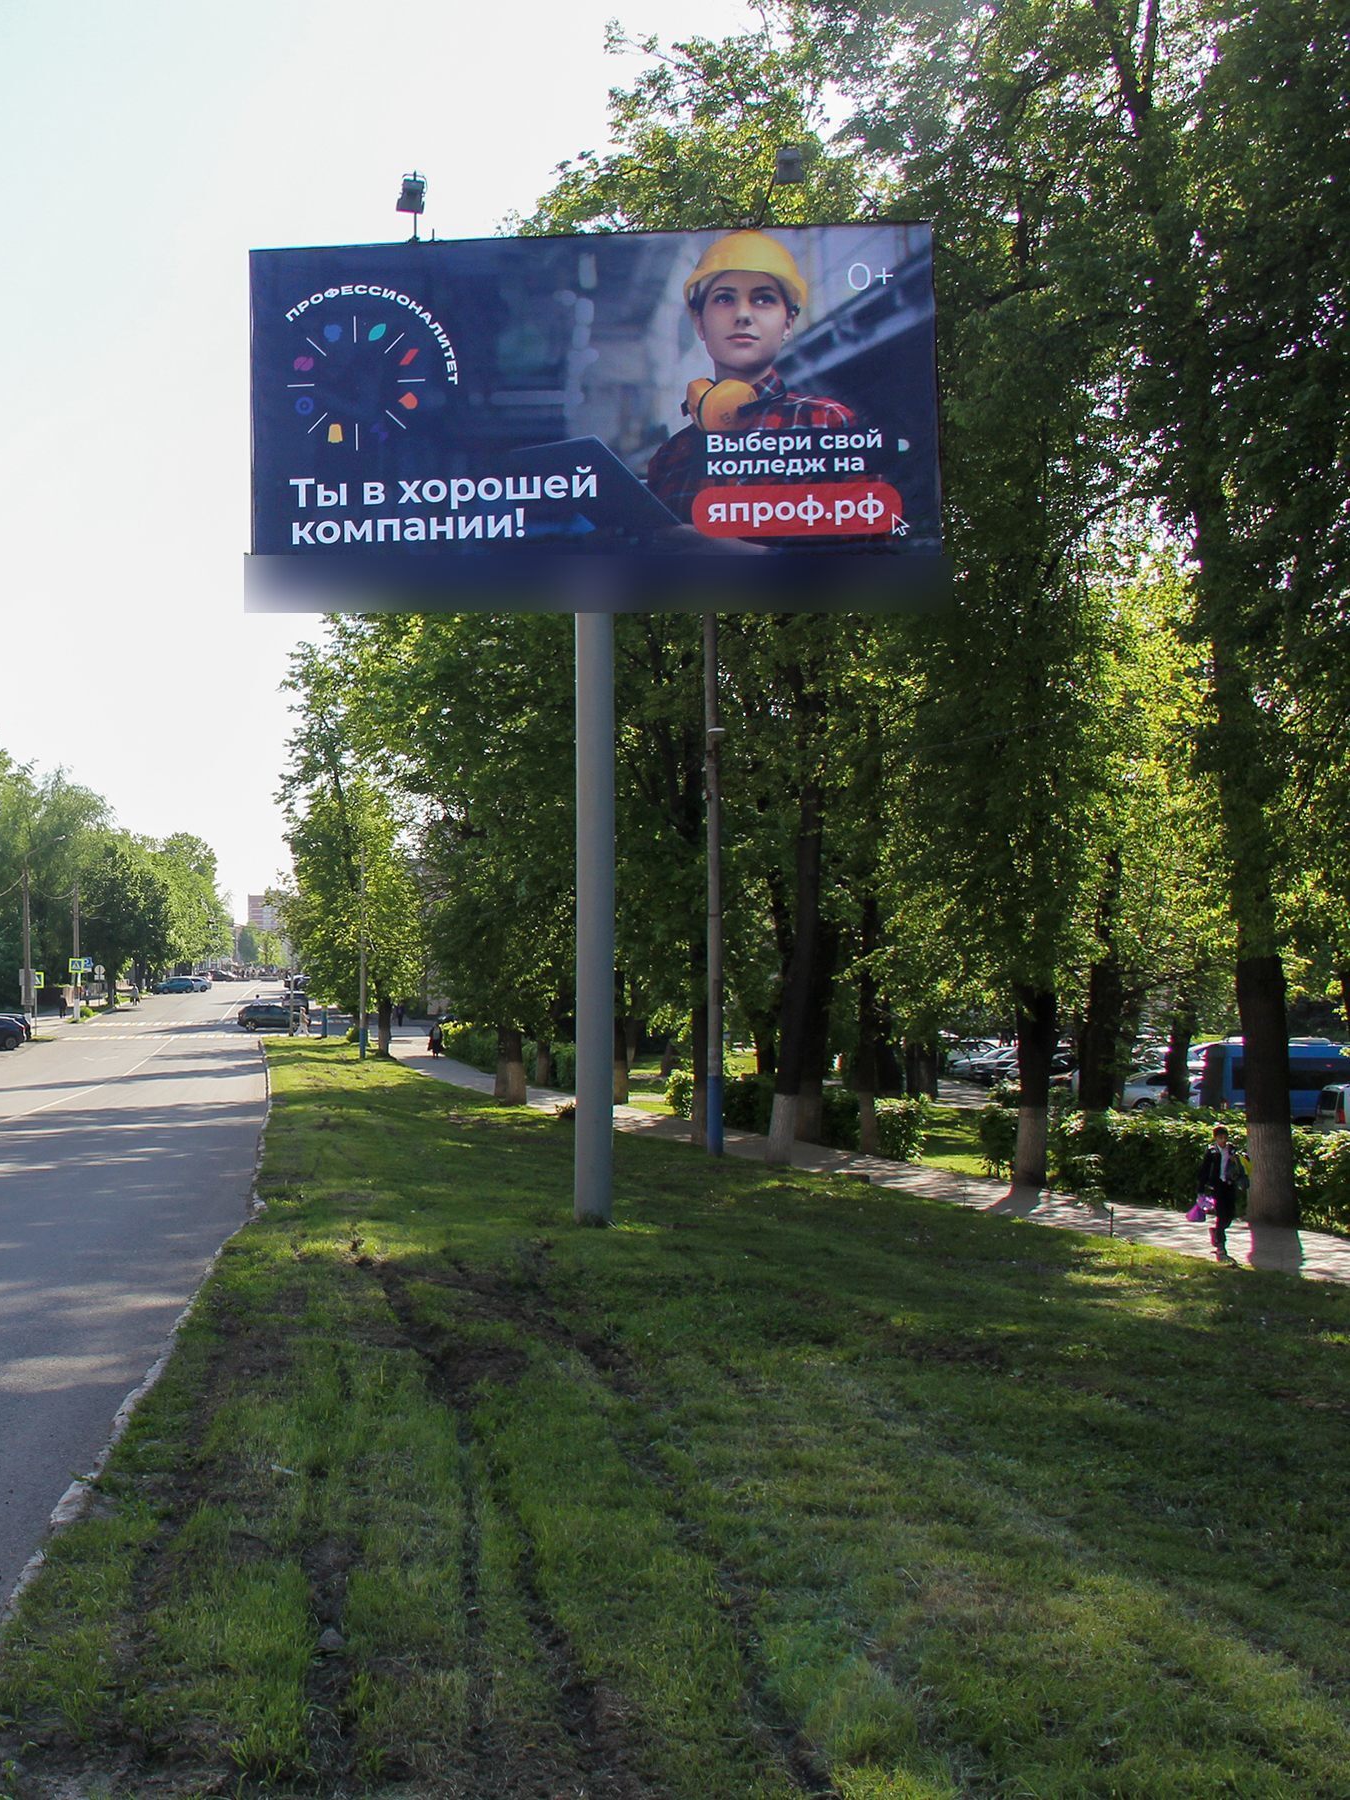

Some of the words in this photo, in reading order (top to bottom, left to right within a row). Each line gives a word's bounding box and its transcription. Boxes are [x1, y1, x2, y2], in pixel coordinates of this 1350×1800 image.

[847, 262, 894, 291] 0+
[284, 284, 458, 386] ПРОФЕССИОНАЛИТЕТ
[706, 431, 812, 455] Выбери
[819, 428, 883, 450] свой
[706, 458, 827, 476] колледж
[833, 456, 865, 473] на
[289, 477, 347, 508] Ты
[362, 480, 386, 506] в
[398, 465, 598, 510] хорошей
[291, 507, 526, 545] компании!
[707, 492, 886, 529] япроф.рф
